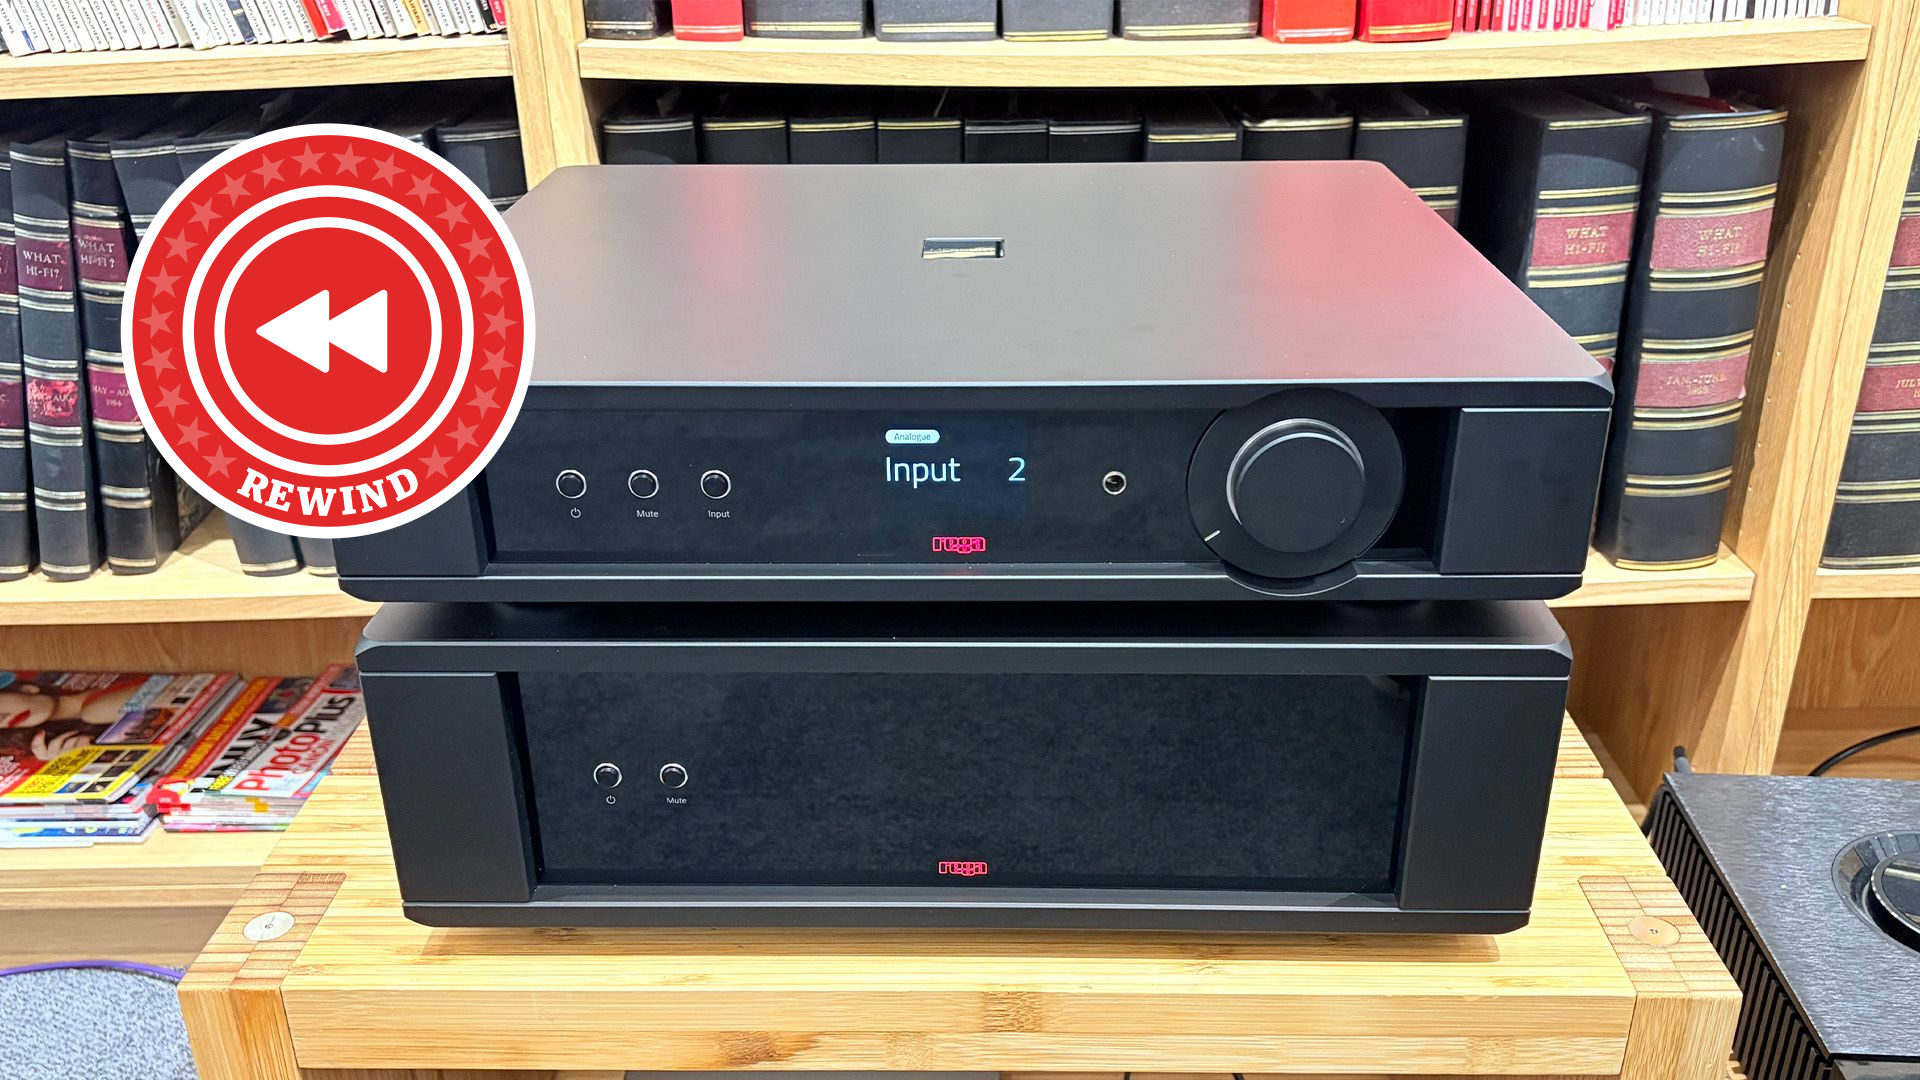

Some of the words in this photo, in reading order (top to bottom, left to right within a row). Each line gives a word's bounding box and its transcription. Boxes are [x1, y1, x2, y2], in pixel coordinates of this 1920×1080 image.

[81, 6, 102, 45] AMPLIFIERS
[97, 11, 114, 40] PLAYERS
[1566, 226, 1608, 239] WHAT
[1699, 226, 1742, 240] WHAT
[79, 240, 115, 253] WHAT
[22, 250, 61, 264] WHAT
[26, 265, 60, 279] HI-FI?
[894, 433, 931, 442] Analogue
[886, 456, 961, 489] Input
[1008, 456, 1026, 482] 2
[636, 509, 659, 519] Mute
[708, 509, 730, 520] Input
[932, 536, 987, 554] rega
[666, 797, 687, 805] Mute
[938, 861, 988, 877] rega
